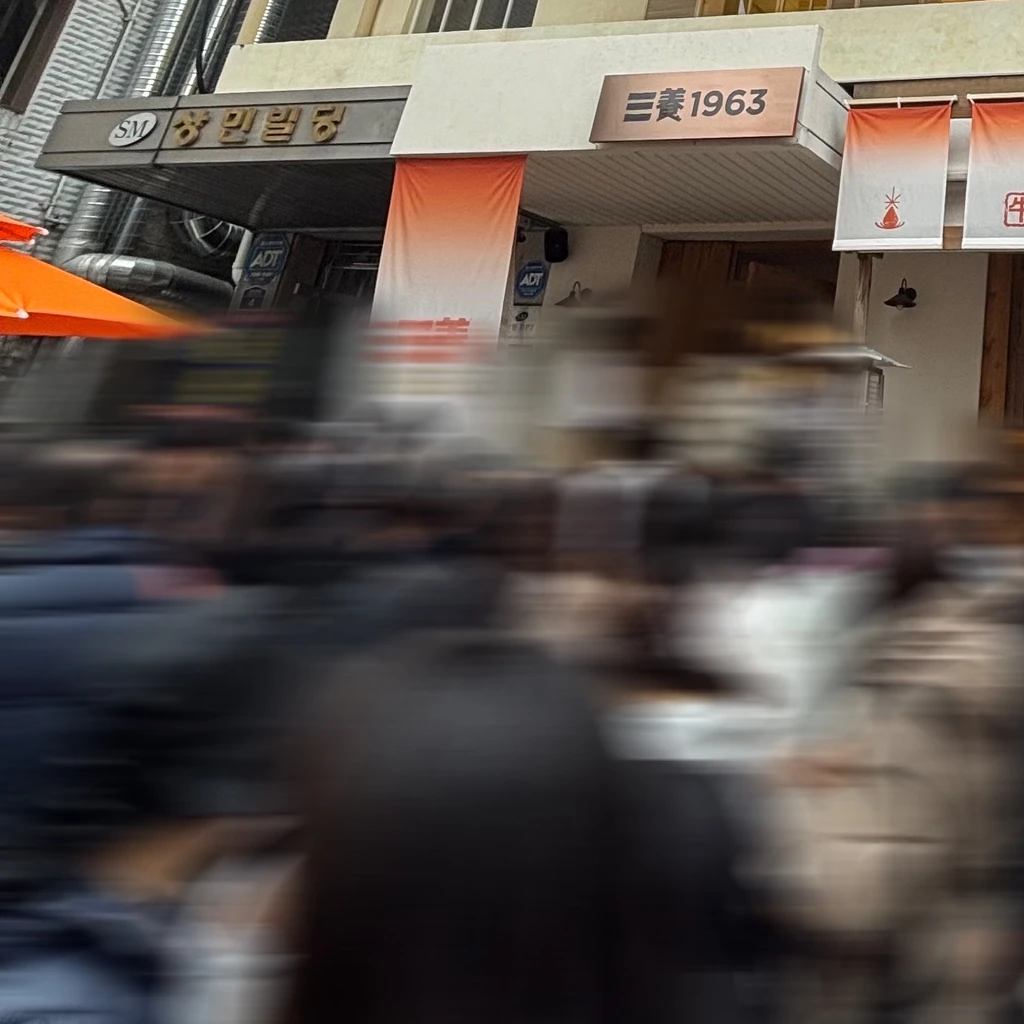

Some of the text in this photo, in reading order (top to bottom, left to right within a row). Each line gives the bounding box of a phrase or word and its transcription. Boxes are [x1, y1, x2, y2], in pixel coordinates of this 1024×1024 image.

[114, 119, 150, 140] SM
[250, 250, 284, 268] ADT
[520, 272, 544, 286] ADT
